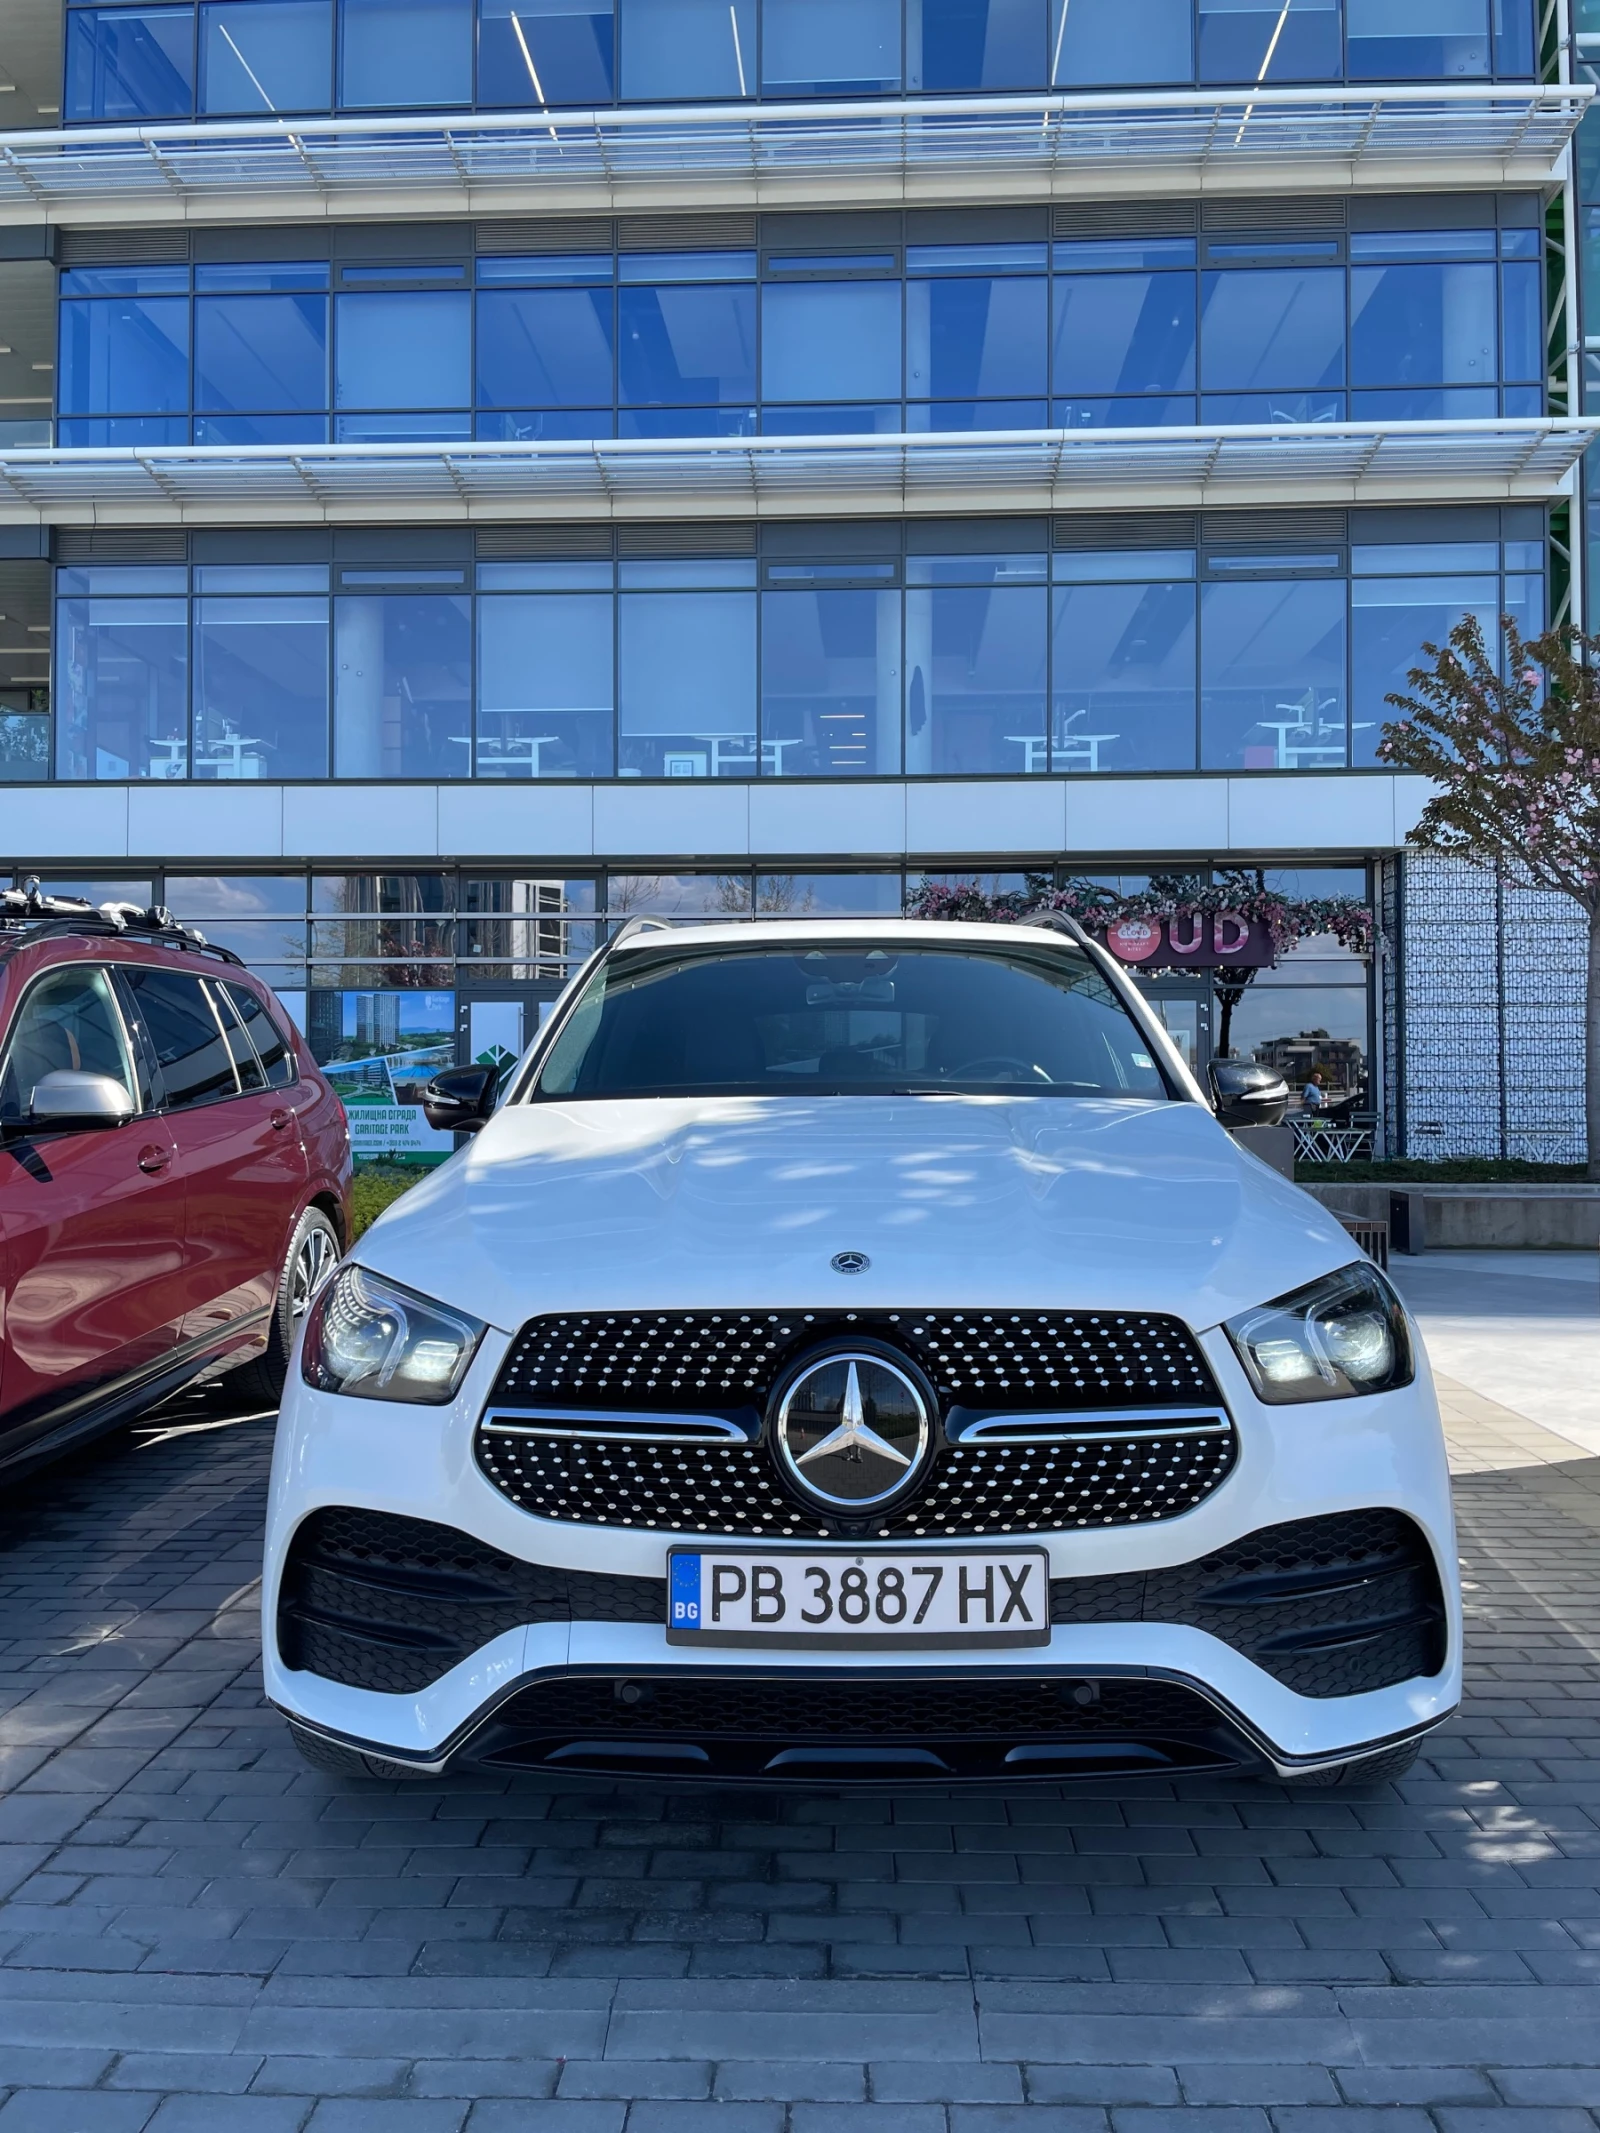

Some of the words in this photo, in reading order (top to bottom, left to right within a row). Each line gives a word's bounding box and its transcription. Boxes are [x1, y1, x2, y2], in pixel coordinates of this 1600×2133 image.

[348, 1109, 387, 1121] ЖИЛИЩНА
[388, 1109, 417, 1121] СГРАДА
[355, 1124, 388, 1135] GARITAGE
[390, 1124, 410, 1135] PARK
[712, 1564, 786, 1624] PB
[801, 1566, 943, 1625] 3887
[959, 1564, 1034, 1624] HX
[675, 1602, 698, 1619] BG
